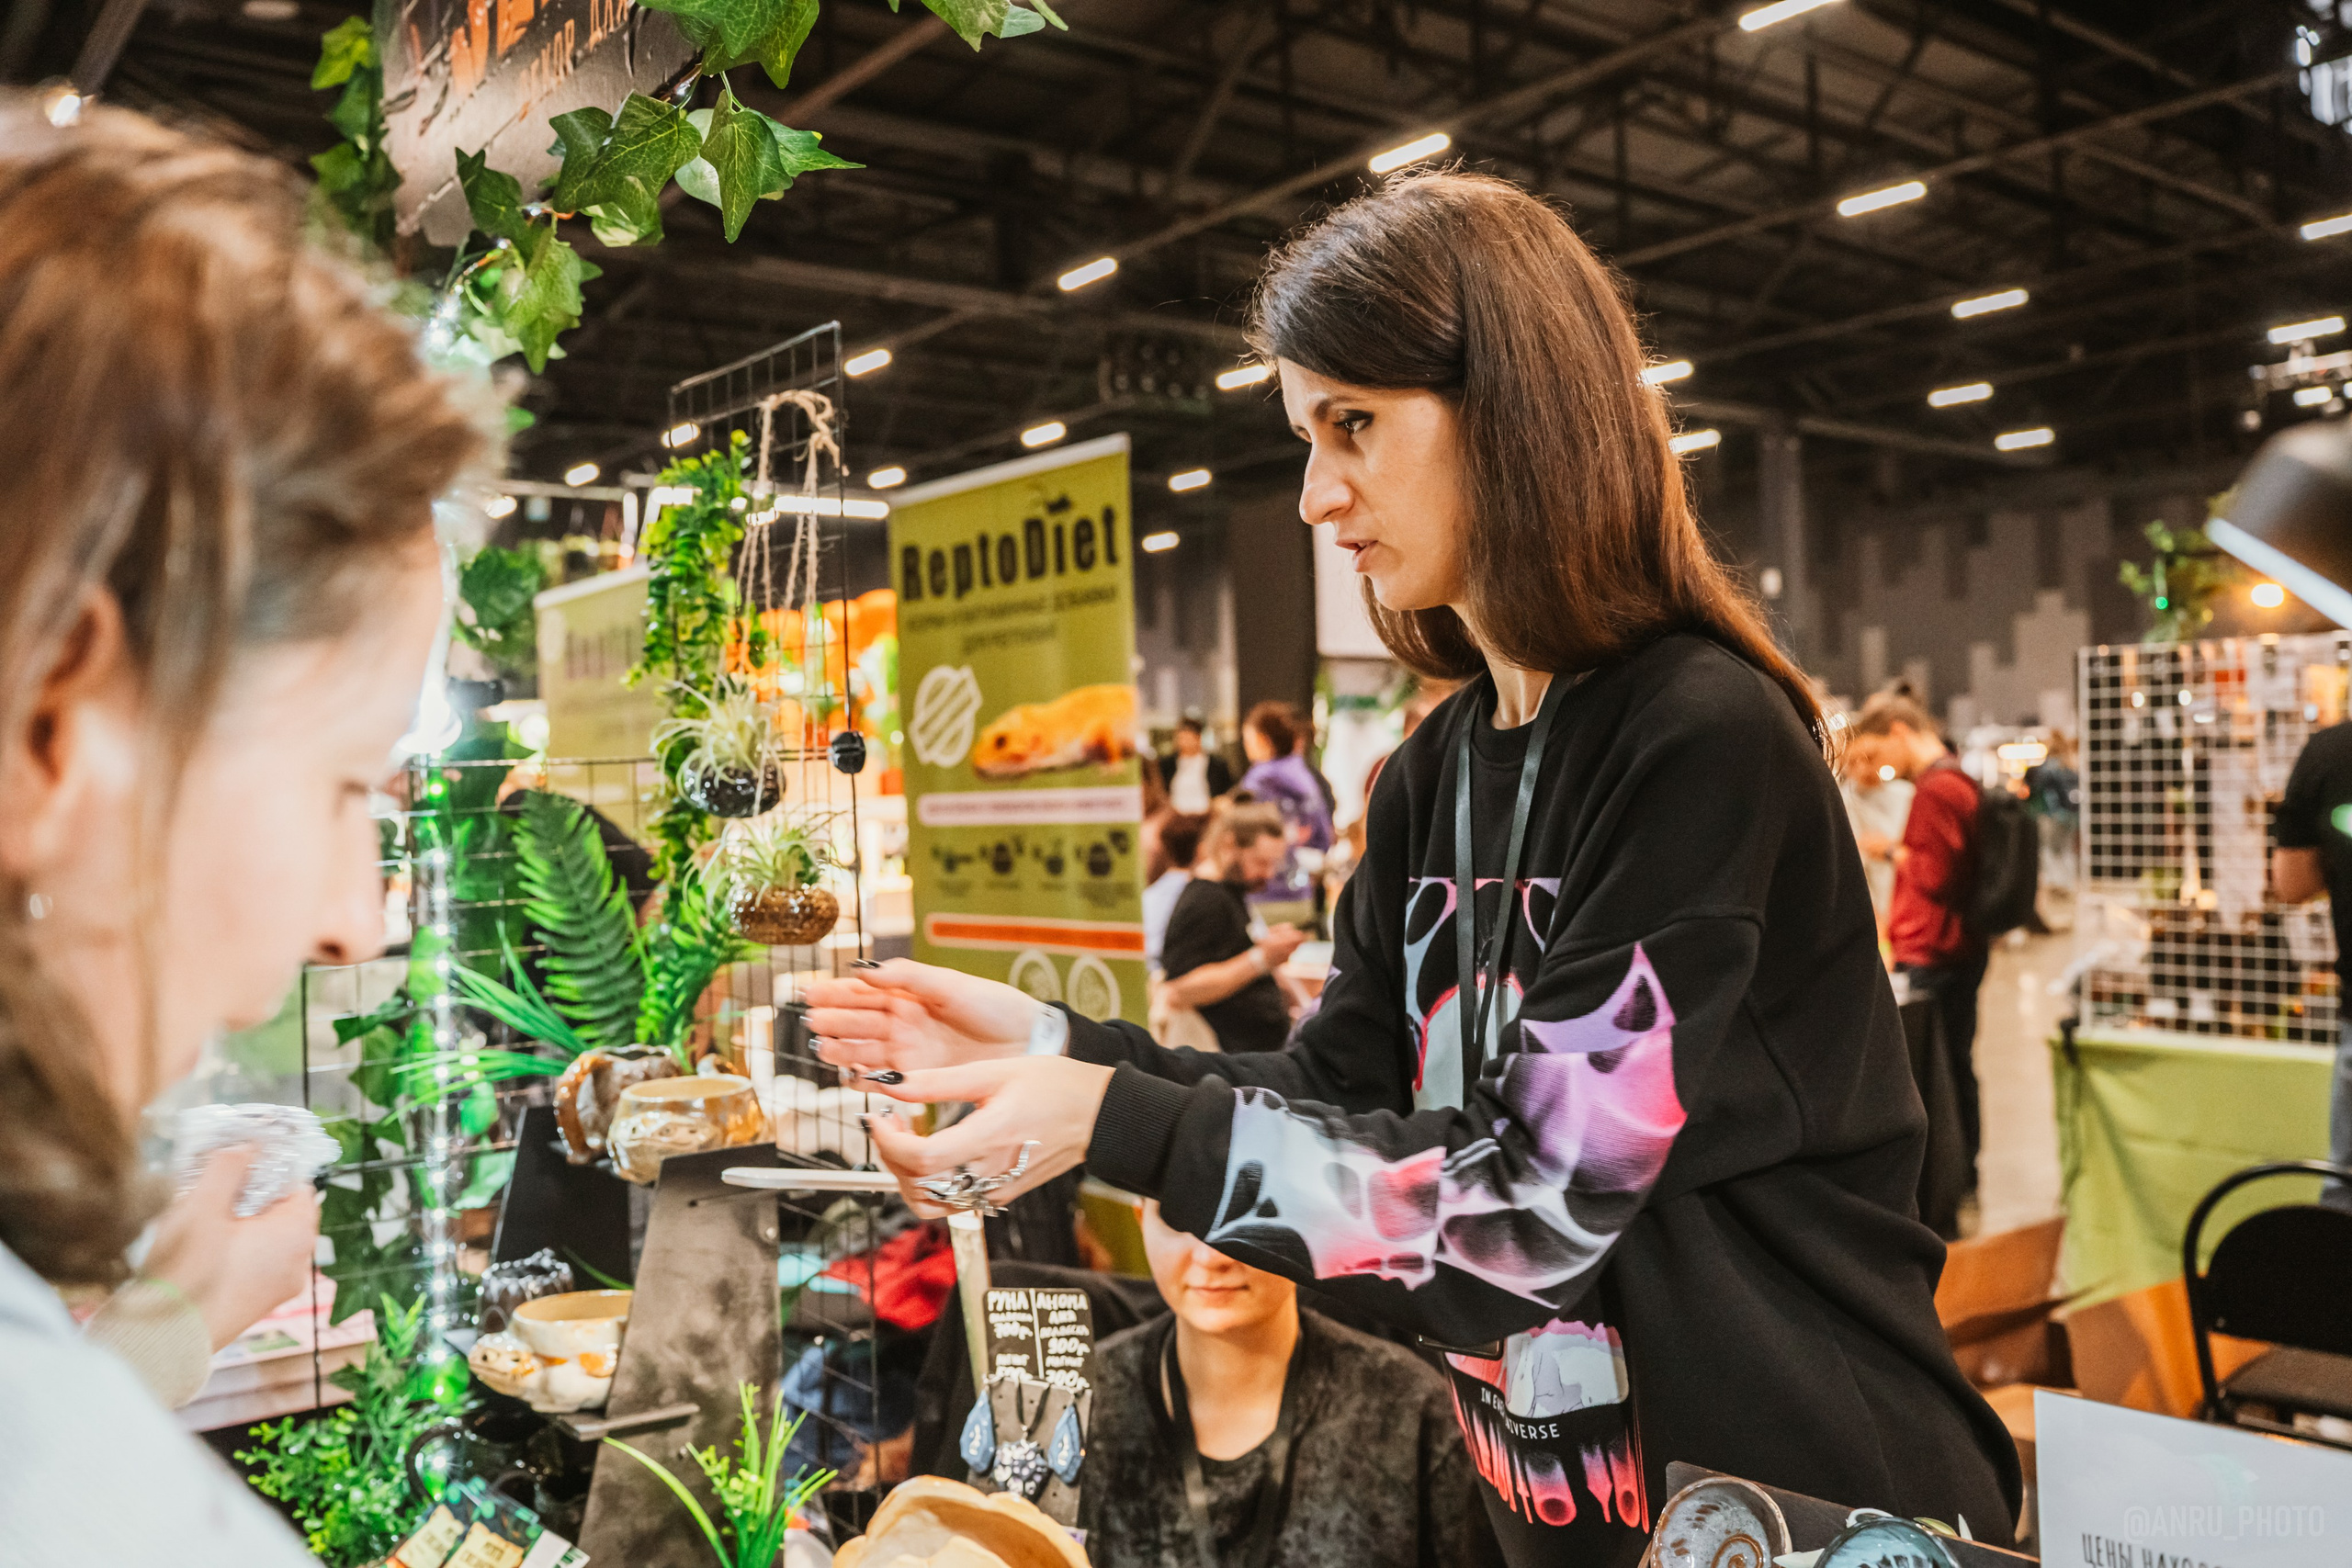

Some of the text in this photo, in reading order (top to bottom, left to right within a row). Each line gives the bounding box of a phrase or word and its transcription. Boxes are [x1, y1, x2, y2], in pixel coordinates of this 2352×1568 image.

[901, 504, 1119, 602] ReptoDiet
[988, 1291, 1029, 1312] РУНА
[1481, 1387, 1492, 1405] IN
[1505, 1416, 1560, 1439] NIVERSE
